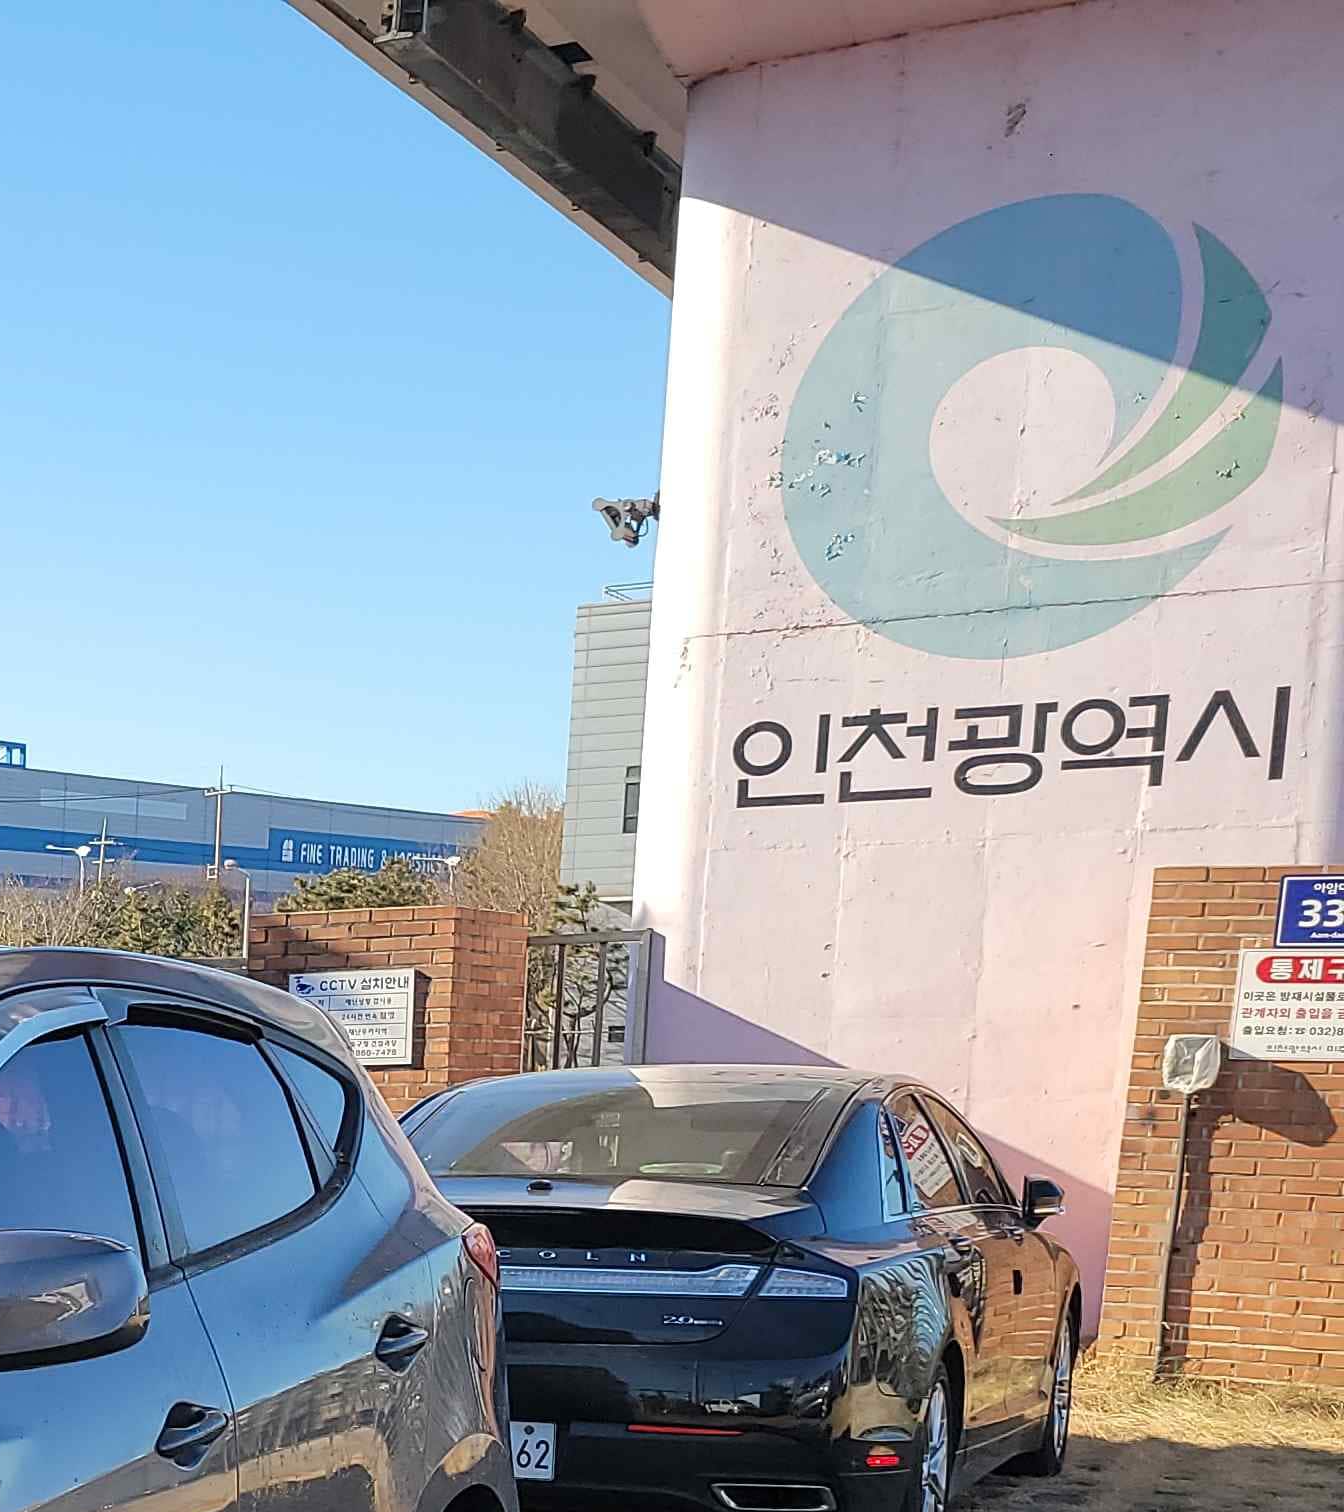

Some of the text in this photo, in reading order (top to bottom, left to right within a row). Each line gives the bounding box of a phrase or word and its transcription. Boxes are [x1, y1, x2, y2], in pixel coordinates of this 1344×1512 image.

[731, 686, 1292, 808] 인천광역시
[300, 843, 323, 864] FINE
[330, 845, 374, 868] TRADING
[320, 976, 409, 991] CCTV 설치안내
[517, 1439, 549, 1469] 62
